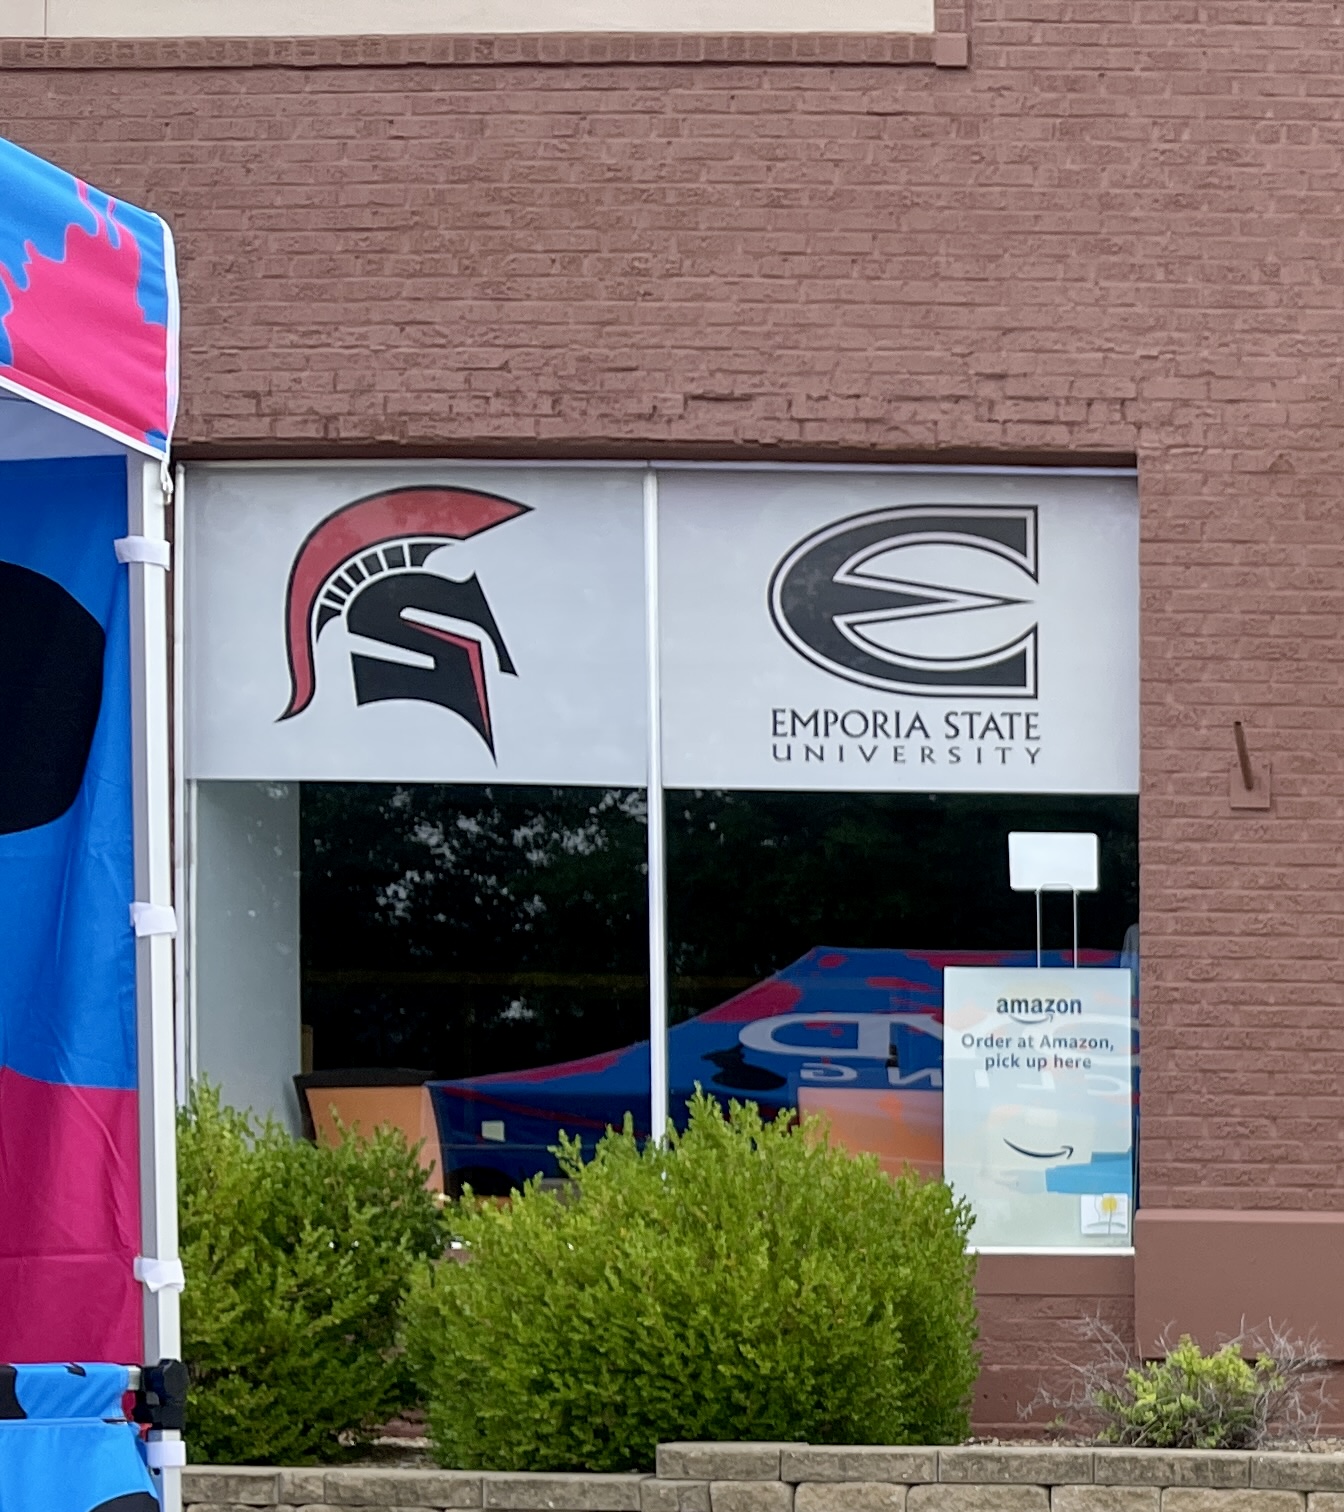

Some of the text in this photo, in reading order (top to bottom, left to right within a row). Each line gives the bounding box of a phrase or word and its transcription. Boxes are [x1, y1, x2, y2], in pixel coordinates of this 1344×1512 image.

[770, 708, 1041, 741] EMPORIA STATE
[771, 743, 1042, 765] UNIVERSITY
[996, 997, 1082, 1015] amazon
[961, 1033, 1114, 1051] Order at Amazon,
[985, 1053, 1092, 1072] pick up here
